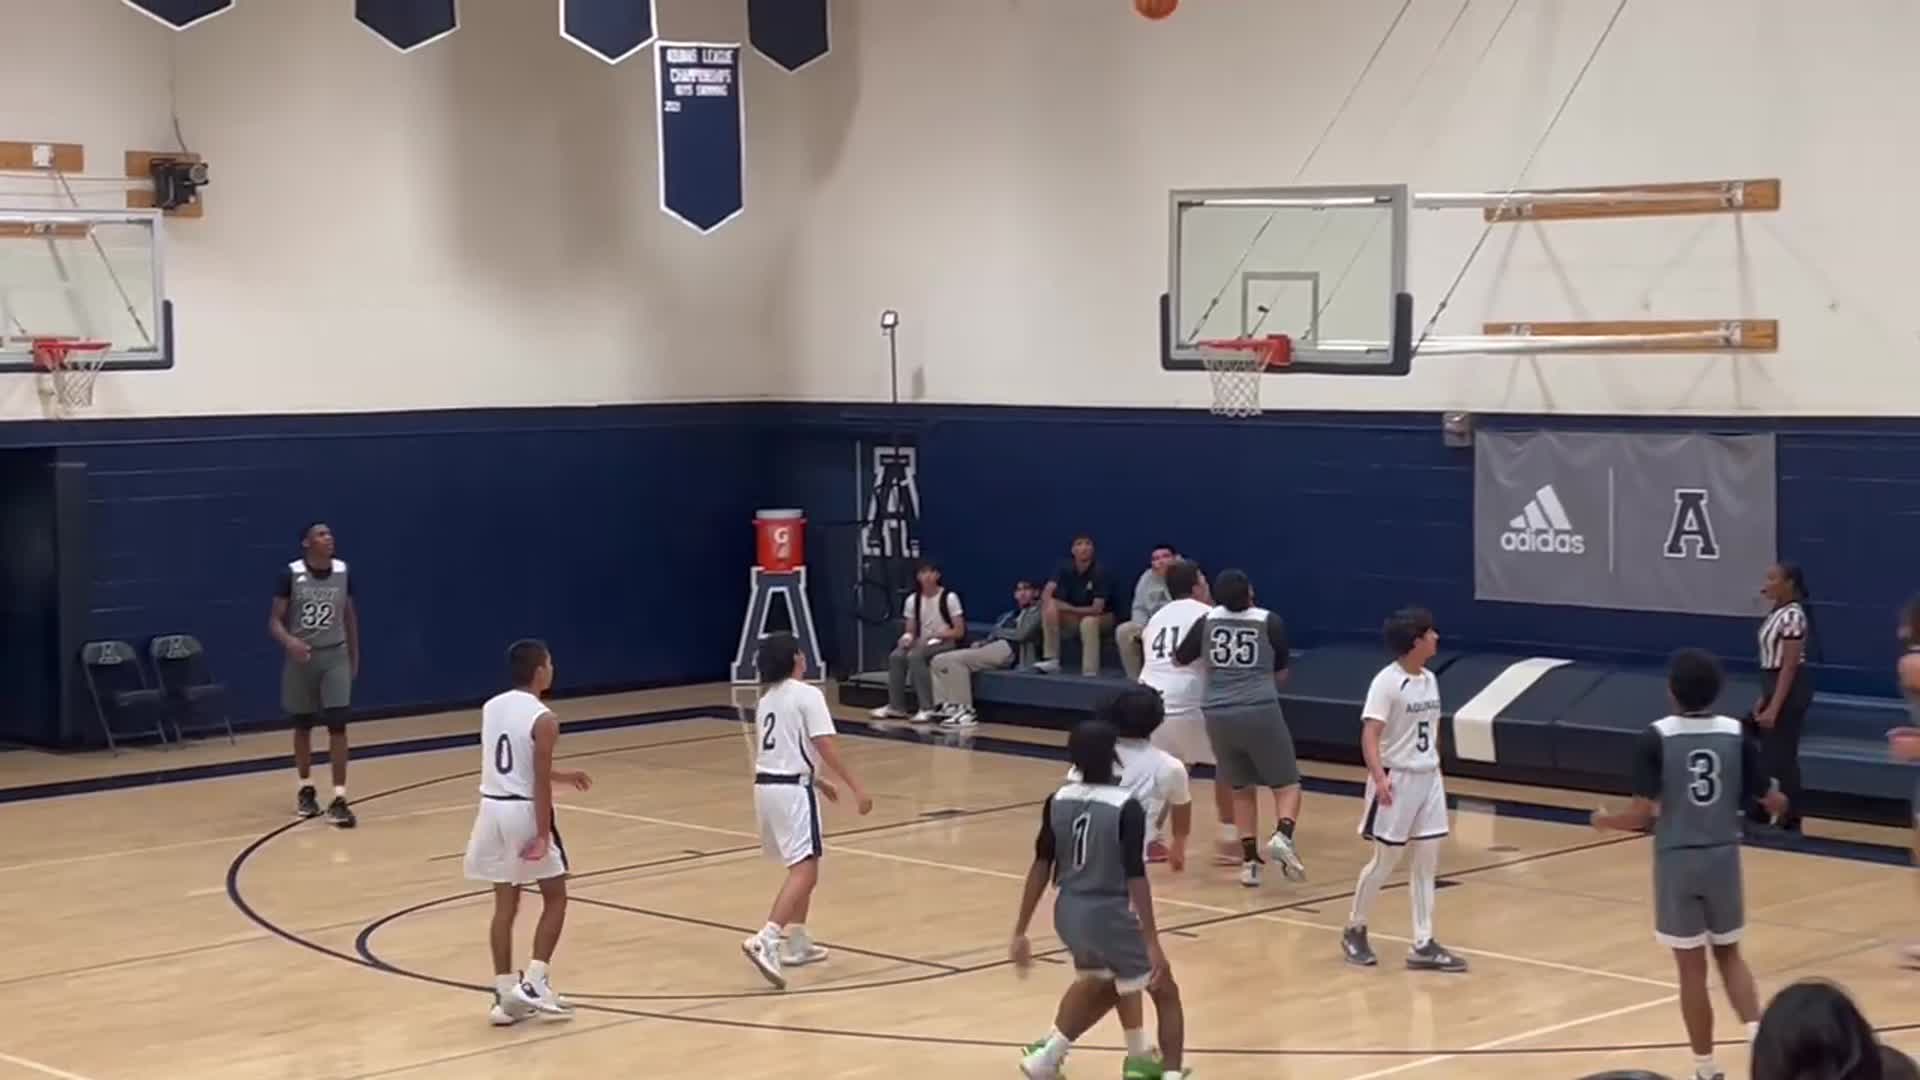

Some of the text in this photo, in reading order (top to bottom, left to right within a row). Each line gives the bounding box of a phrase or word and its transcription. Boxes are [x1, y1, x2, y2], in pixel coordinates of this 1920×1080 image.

[1501, 527, 1585, 555] adidas
[1663, 488, 1720, 559] A
[301, 600, 336, 629] 32
[1152, 625, 1180, 659] 41
[1209, 626, 1259, 668] 35
[763, 711, 776, 751] 2
[1416, 721, 1430, 753] 5
[495, 732, 514, 776] 0
[1687, 748, 1722, 807] 3
[1072, 811, 1092, 873] 1
